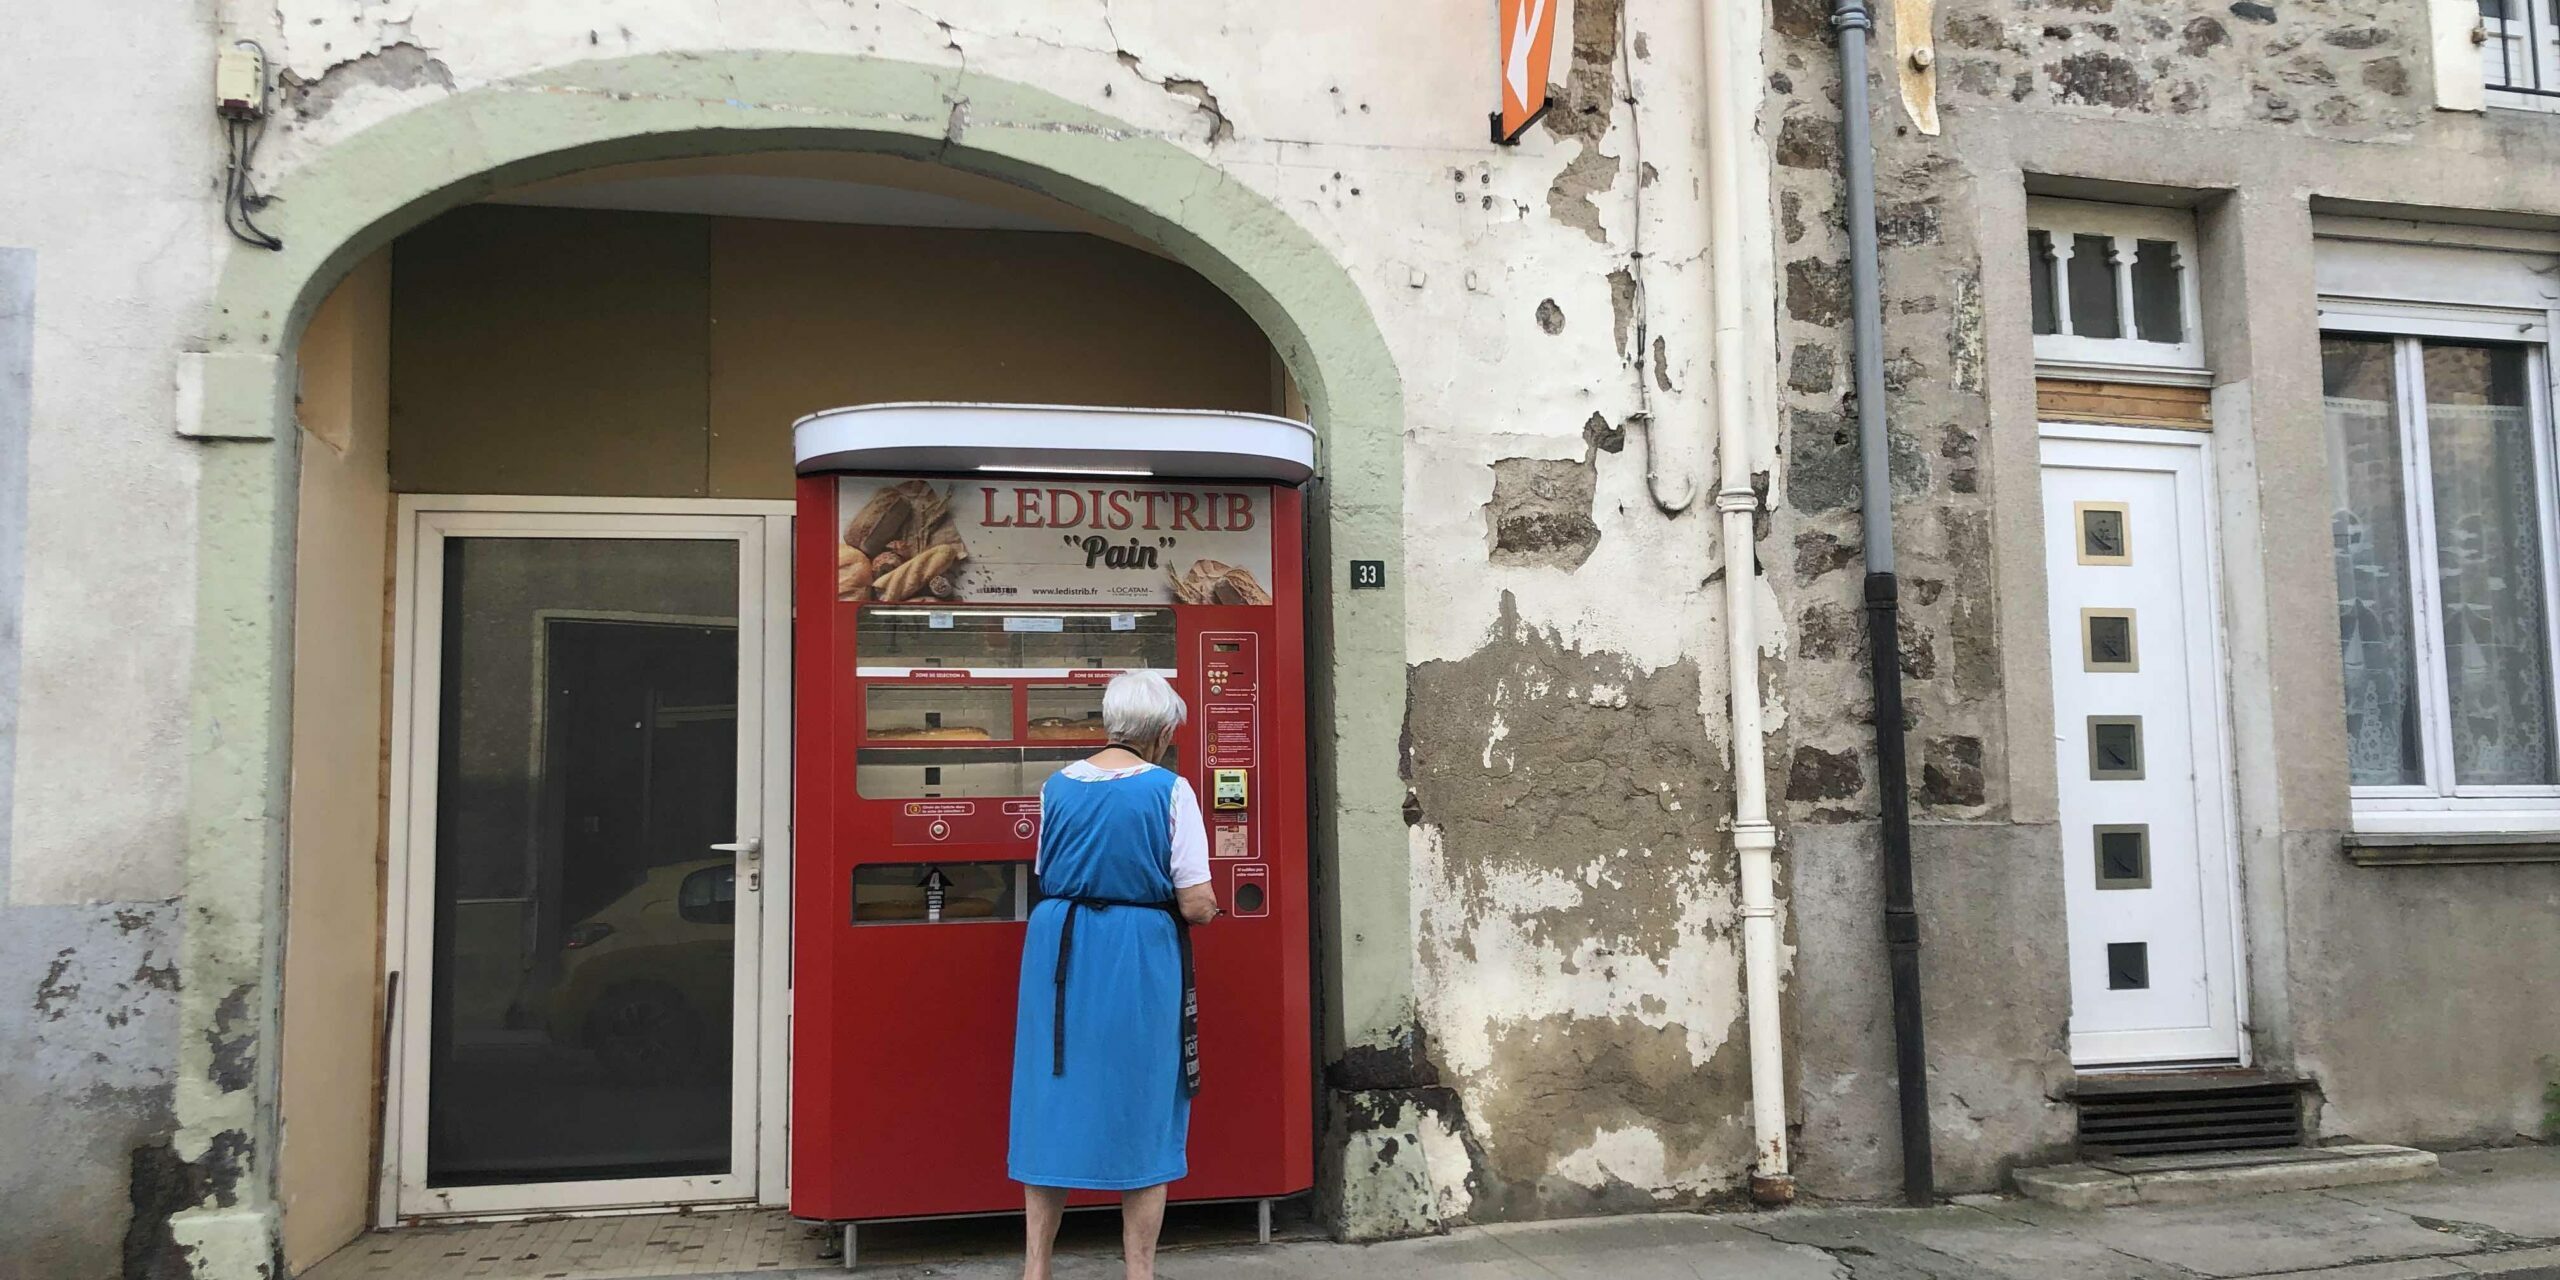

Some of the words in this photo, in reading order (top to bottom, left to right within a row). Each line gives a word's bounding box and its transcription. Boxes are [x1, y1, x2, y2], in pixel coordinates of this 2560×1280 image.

[979, 487, 1256, 532] LEDISTRIB
[1359, 565, 1377, 584] 33
[1031, 587, 1099, 596] www.ledistrib.fr
[929, 872, 941, 890] 4
